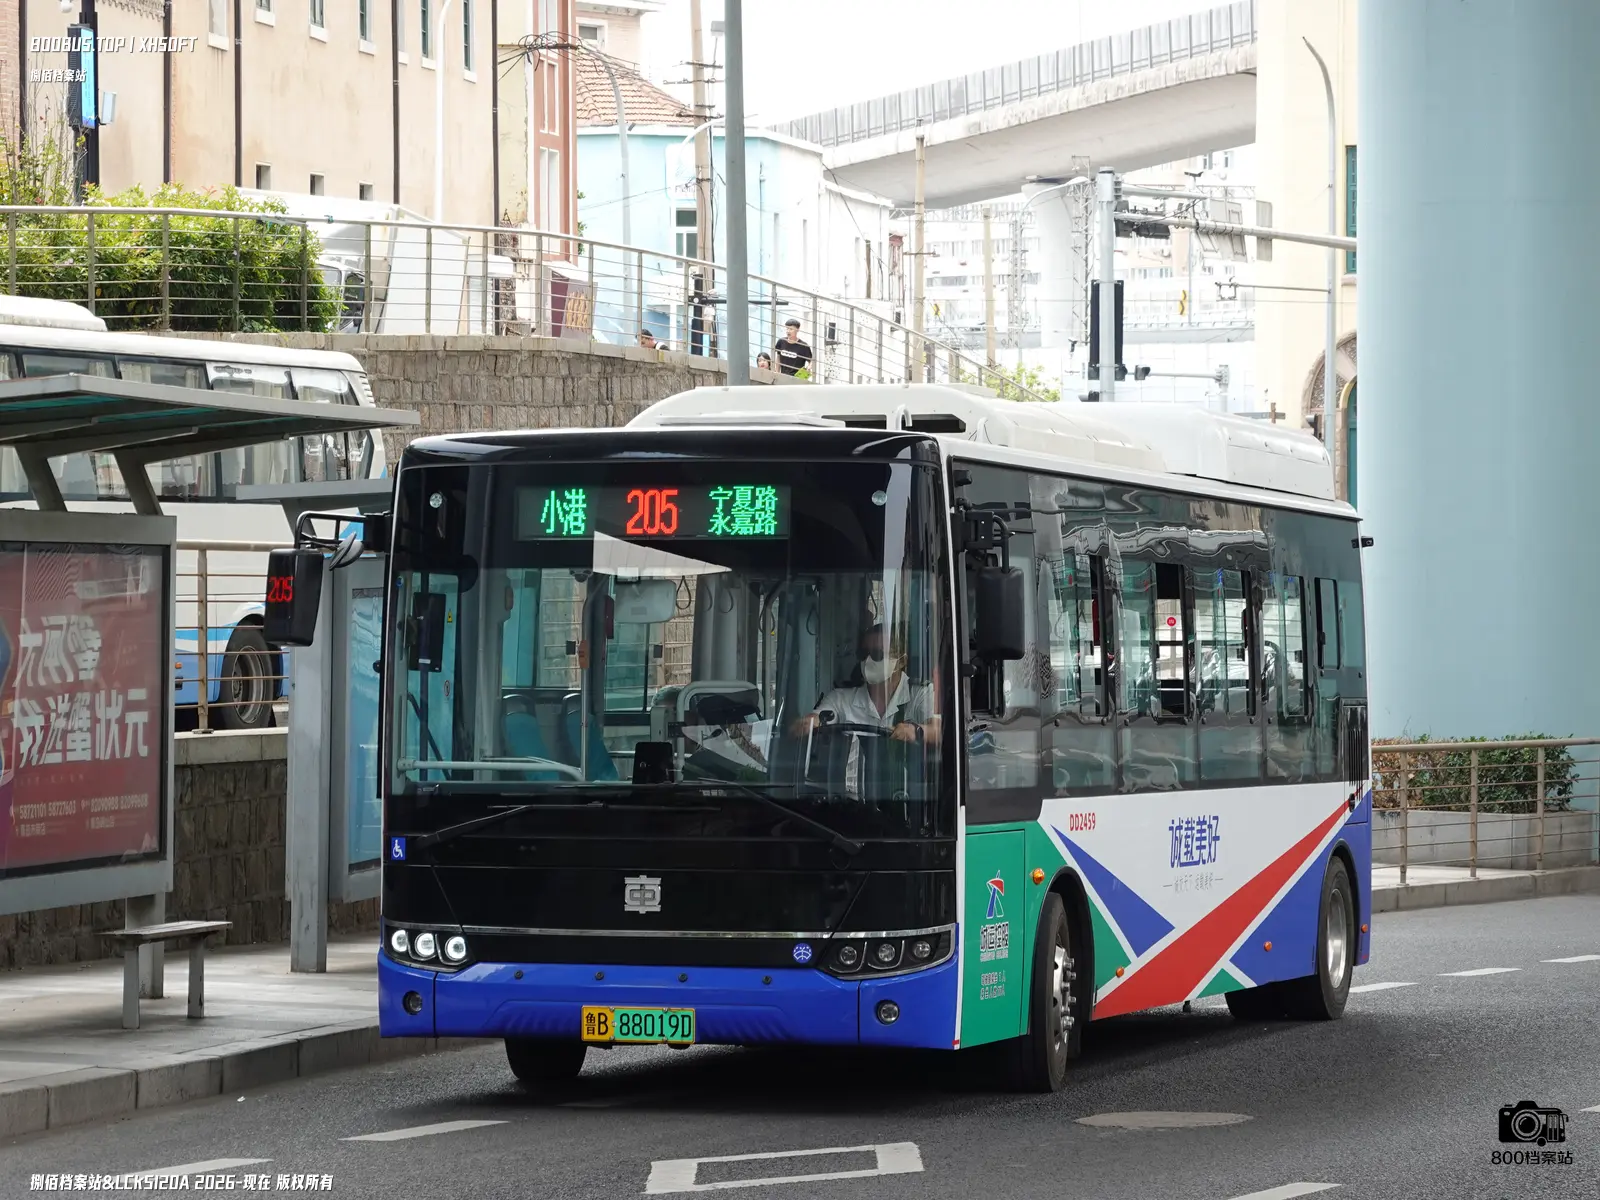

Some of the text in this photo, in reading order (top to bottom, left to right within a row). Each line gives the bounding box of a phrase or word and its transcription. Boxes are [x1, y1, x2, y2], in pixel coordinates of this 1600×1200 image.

[540, 488, 587, 535] 小港
[626, 488, 679, 535] 205
[708, 485, 778, 511] 宁夏路
[708, 510, 778, 535] 永嘉路
[267, 575, 294, 603] 205
[1069, 812, 1096, 832] DD2459
[1168, 814, 1221, 869] 诚载美好
